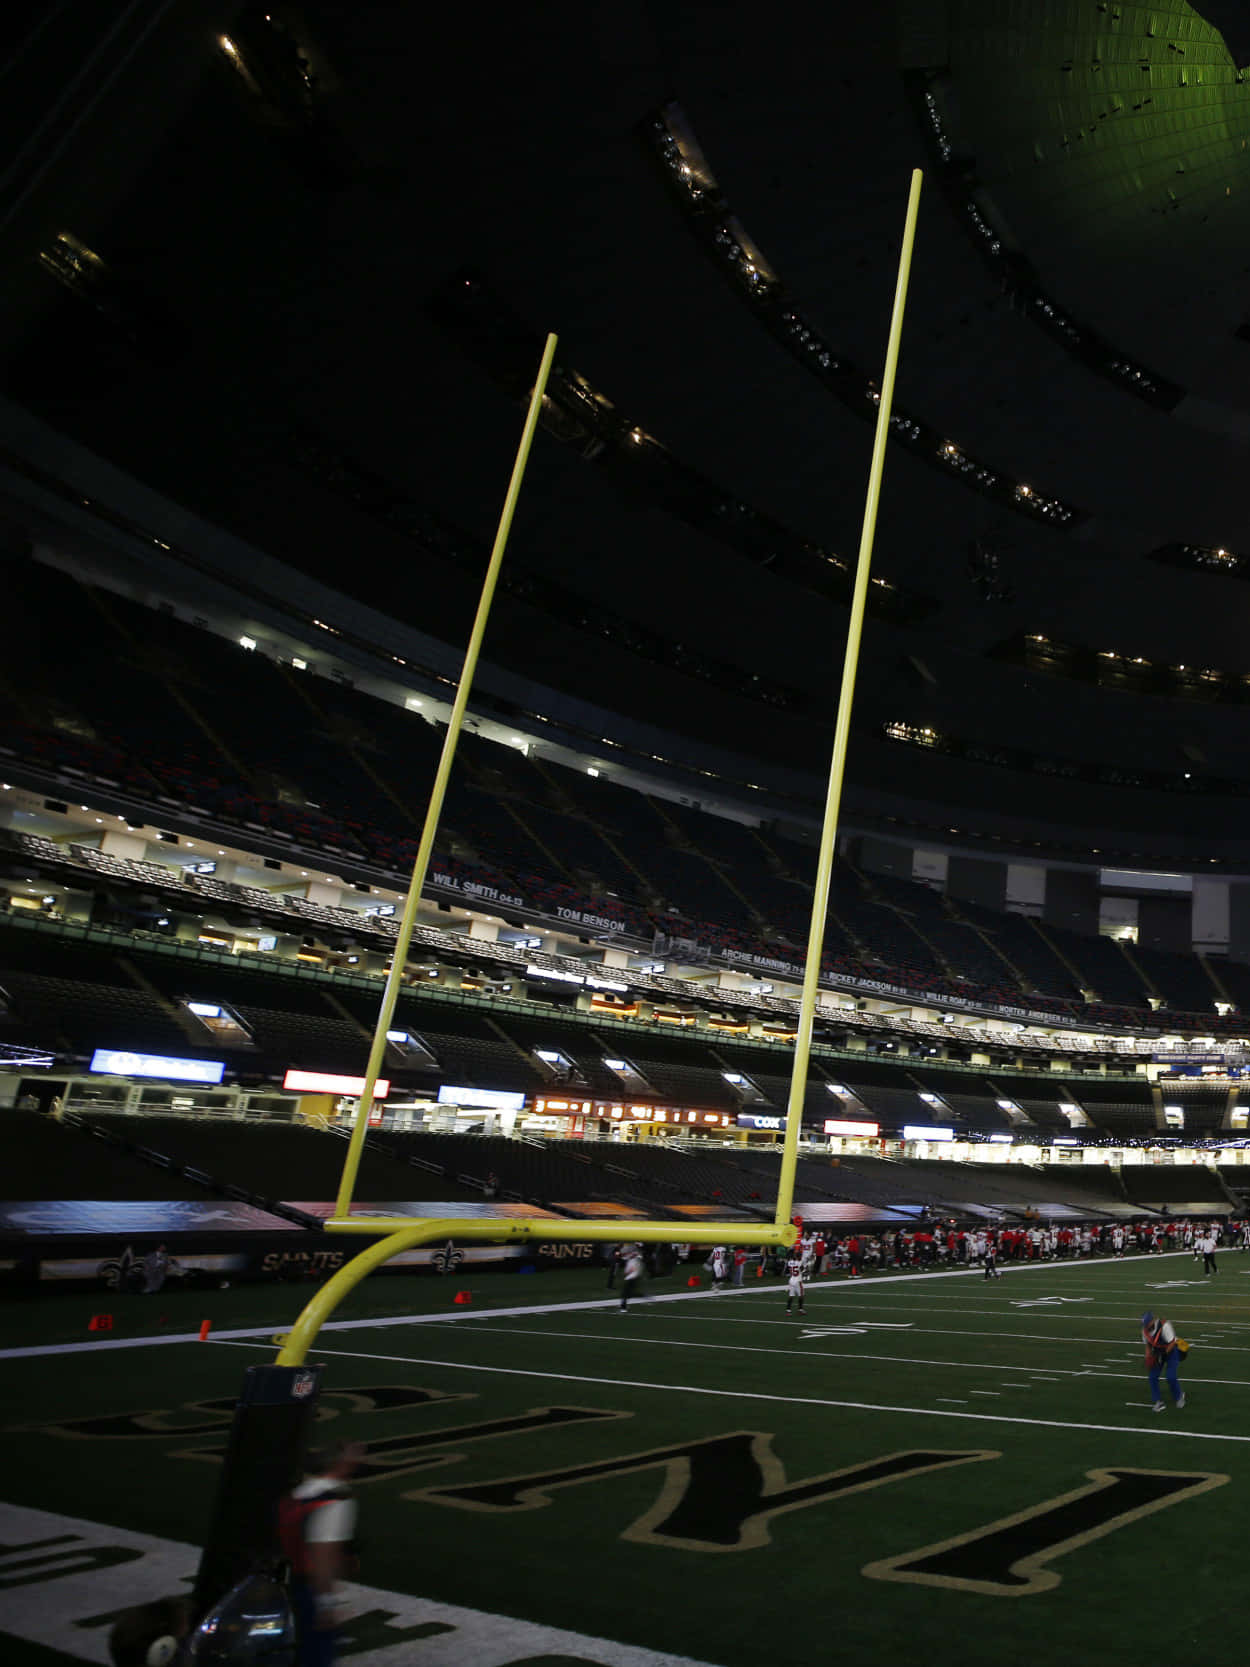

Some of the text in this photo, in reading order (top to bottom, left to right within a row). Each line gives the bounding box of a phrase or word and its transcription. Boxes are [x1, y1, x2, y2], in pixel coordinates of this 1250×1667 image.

[432, 872, 459, 890] WILL
[463, 881, 499, 901] SMITH
[556, 906, 625, 932] TOM BENSON
[721, 947, 753, 962] ARCHIE
[753, 954, 792, 972] MANNING
[860, 978, 892, 993] JACKSON
[537, 1243, 594, 1259] SAINTS
